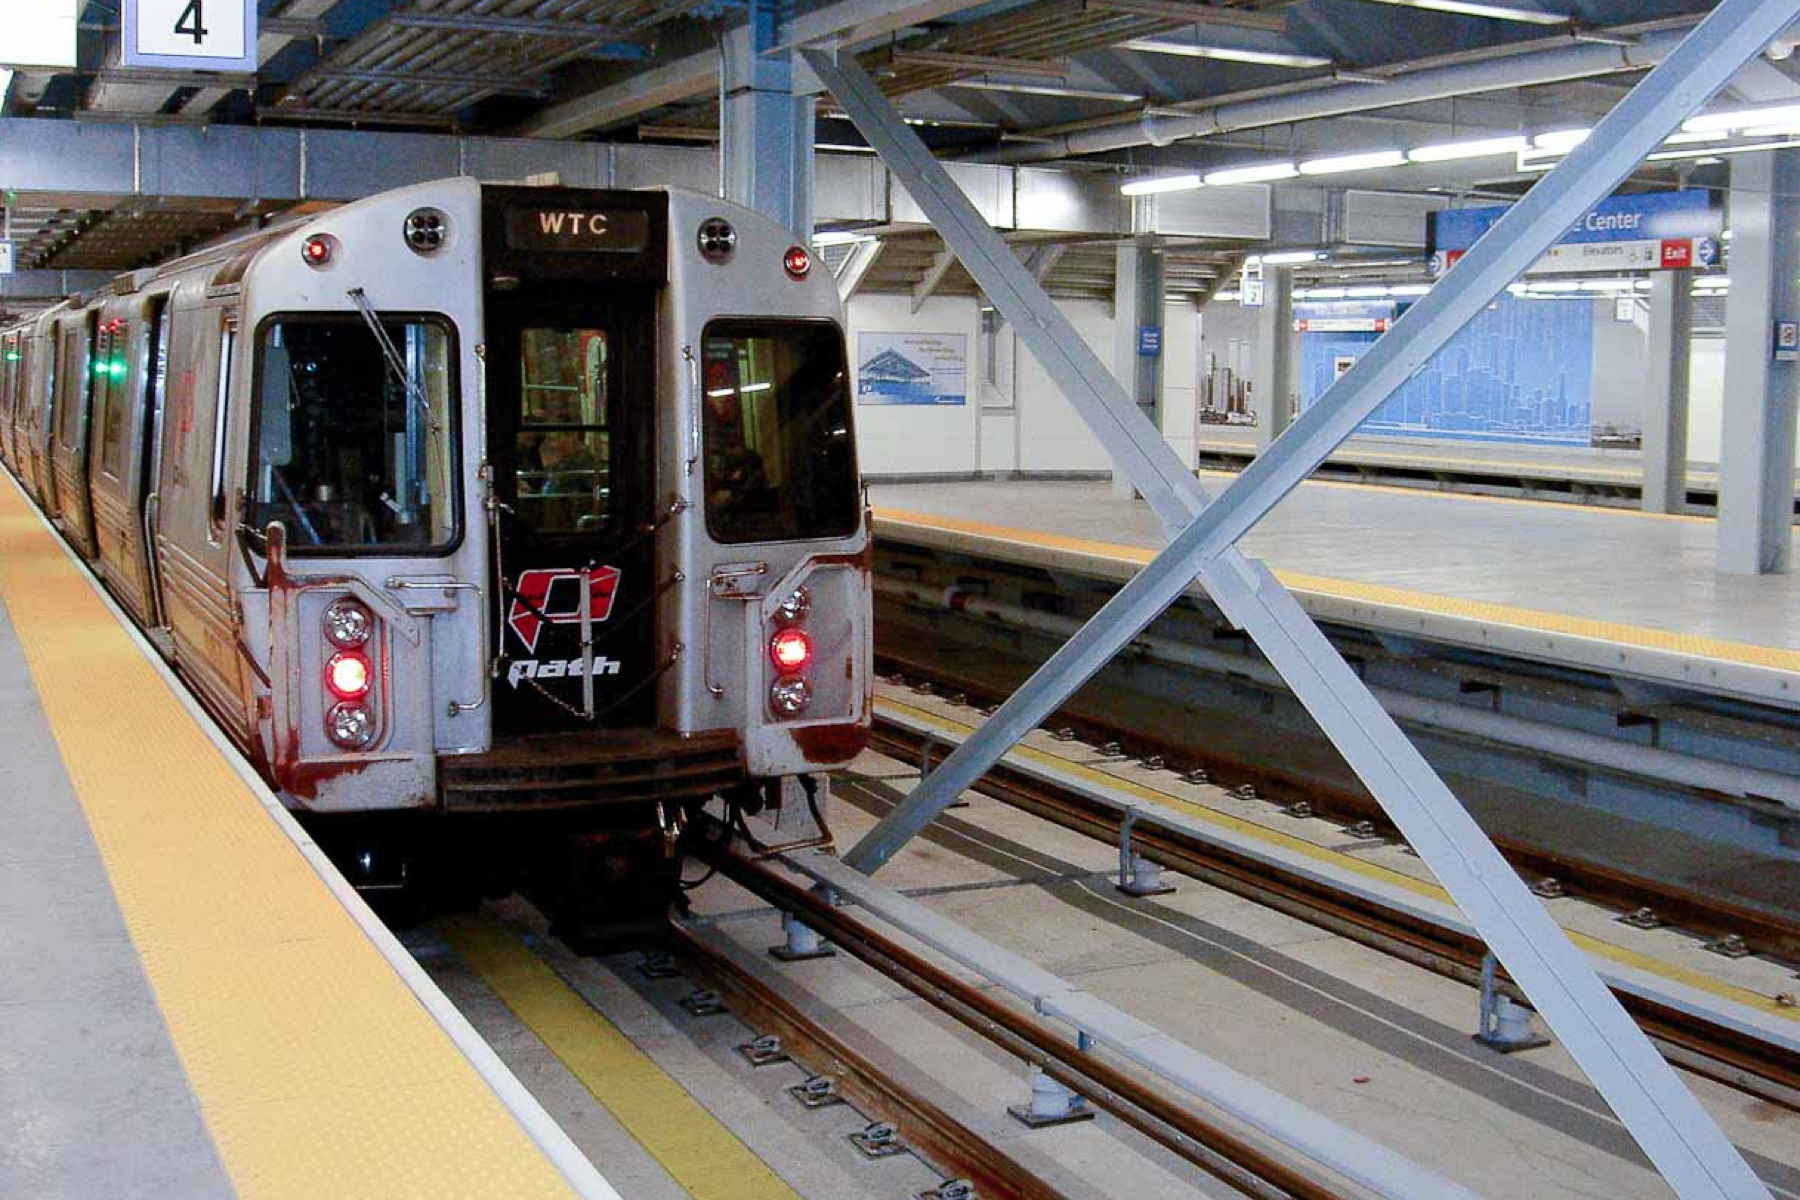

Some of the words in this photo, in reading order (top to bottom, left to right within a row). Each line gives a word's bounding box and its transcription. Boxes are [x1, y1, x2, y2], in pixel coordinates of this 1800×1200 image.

[174, 0, 208, 44] 4
[539, 212, 609, 235] WTC
[1586, 211, 1642, 232] Center
[1583, 245, 1624, 257] Elevators
[1664, 247, 1688, 259] Exit
[508, 656, 622, 689] path
